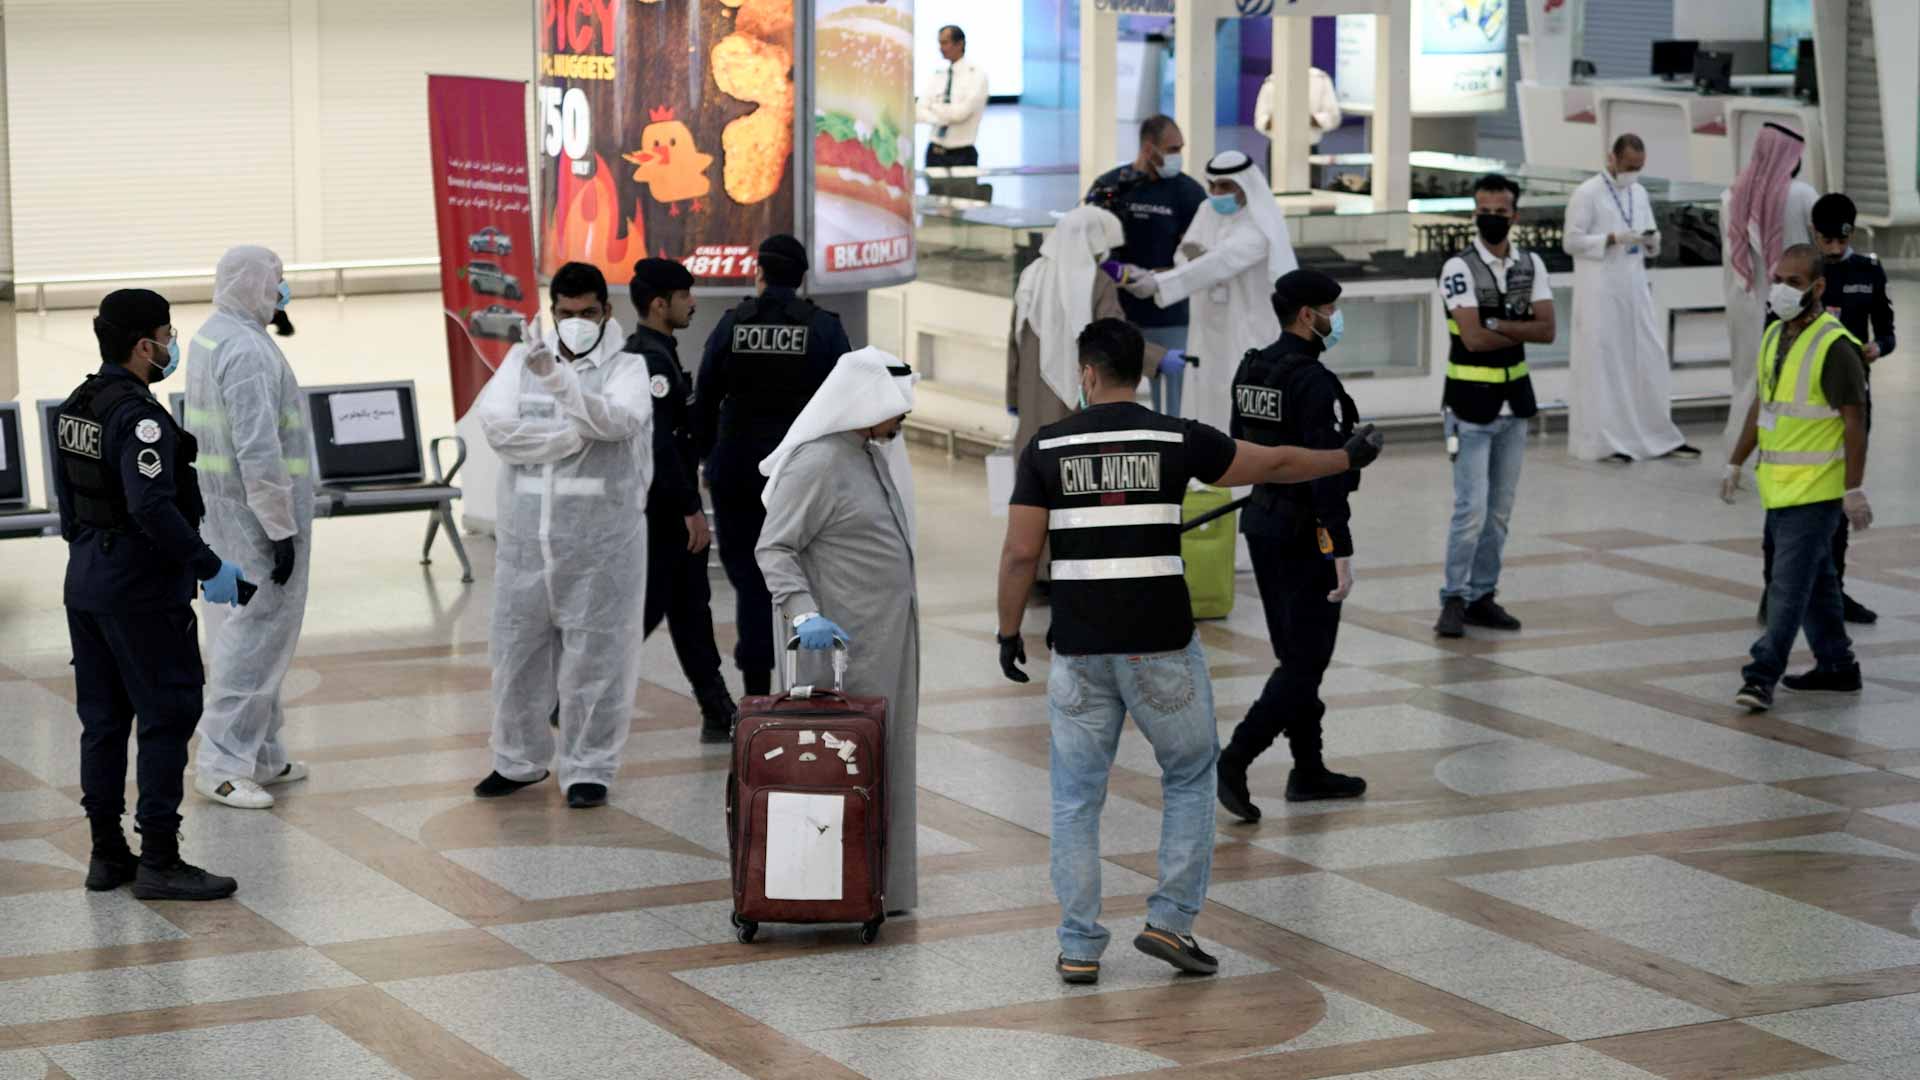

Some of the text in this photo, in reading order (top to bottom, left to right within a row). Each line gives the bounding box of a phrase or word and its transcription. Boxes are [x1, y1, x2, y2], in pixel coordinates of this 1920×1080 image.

[554, 55, 615, 80] NUGGETS
[736, 328, 803, 350] POLICE
[1236, 388, 1276, 417] POLICE
[60, 418, 99, 455] POLICE
[1063, 455, 1157, 492] CIVIL AVIATION
